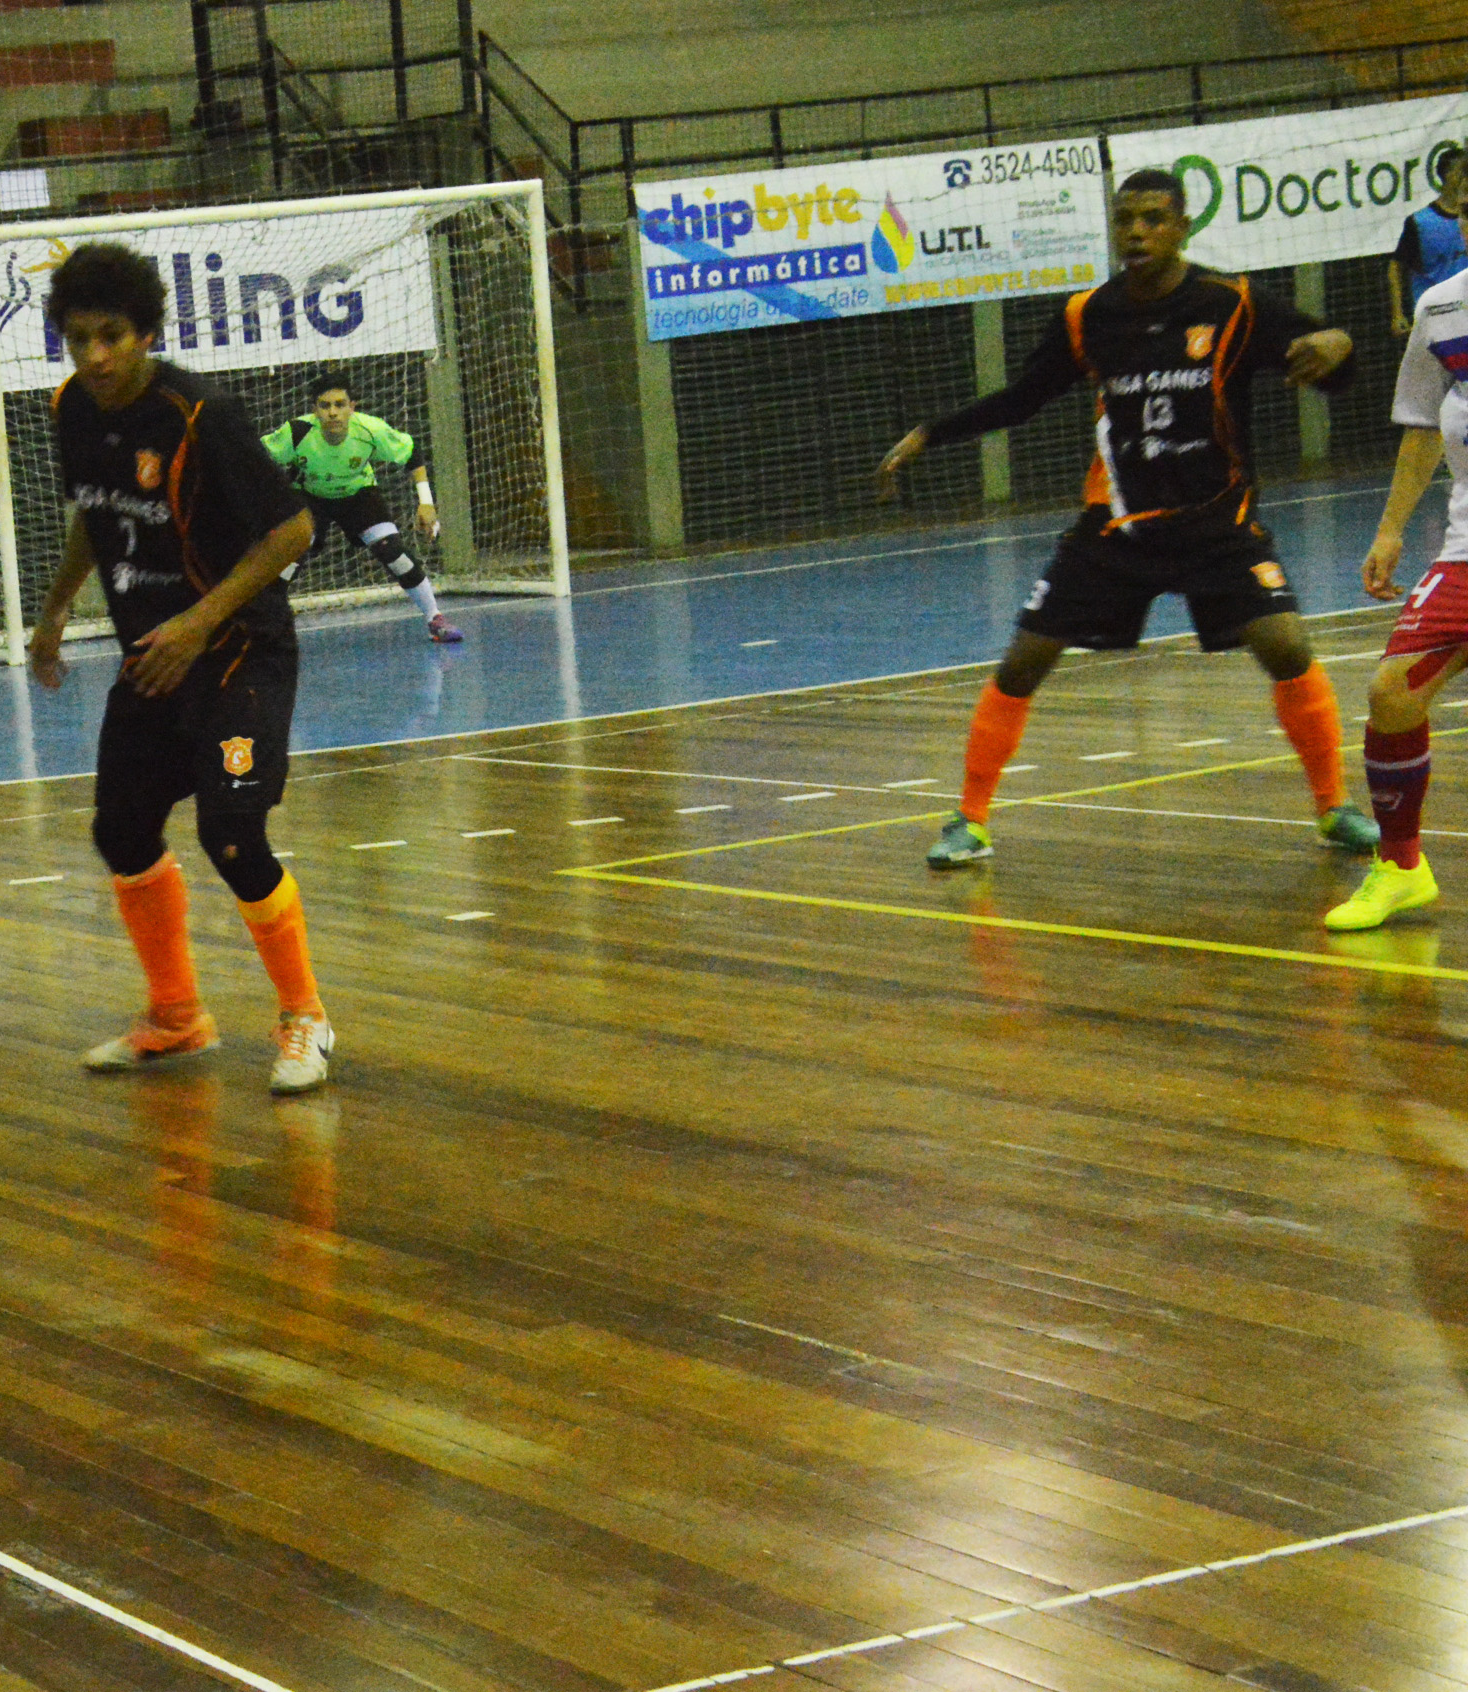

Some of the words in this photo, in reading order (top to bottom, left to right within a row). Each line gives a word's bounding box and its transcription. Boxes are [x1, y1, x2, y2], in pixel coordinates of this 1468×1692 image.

[981, 145, 1096, 185] 3524-4500
[654, 251, 861, 294] informática
[654, 299, 759, 330] tecnologia
[1142, 395, 1174, 432] 13
